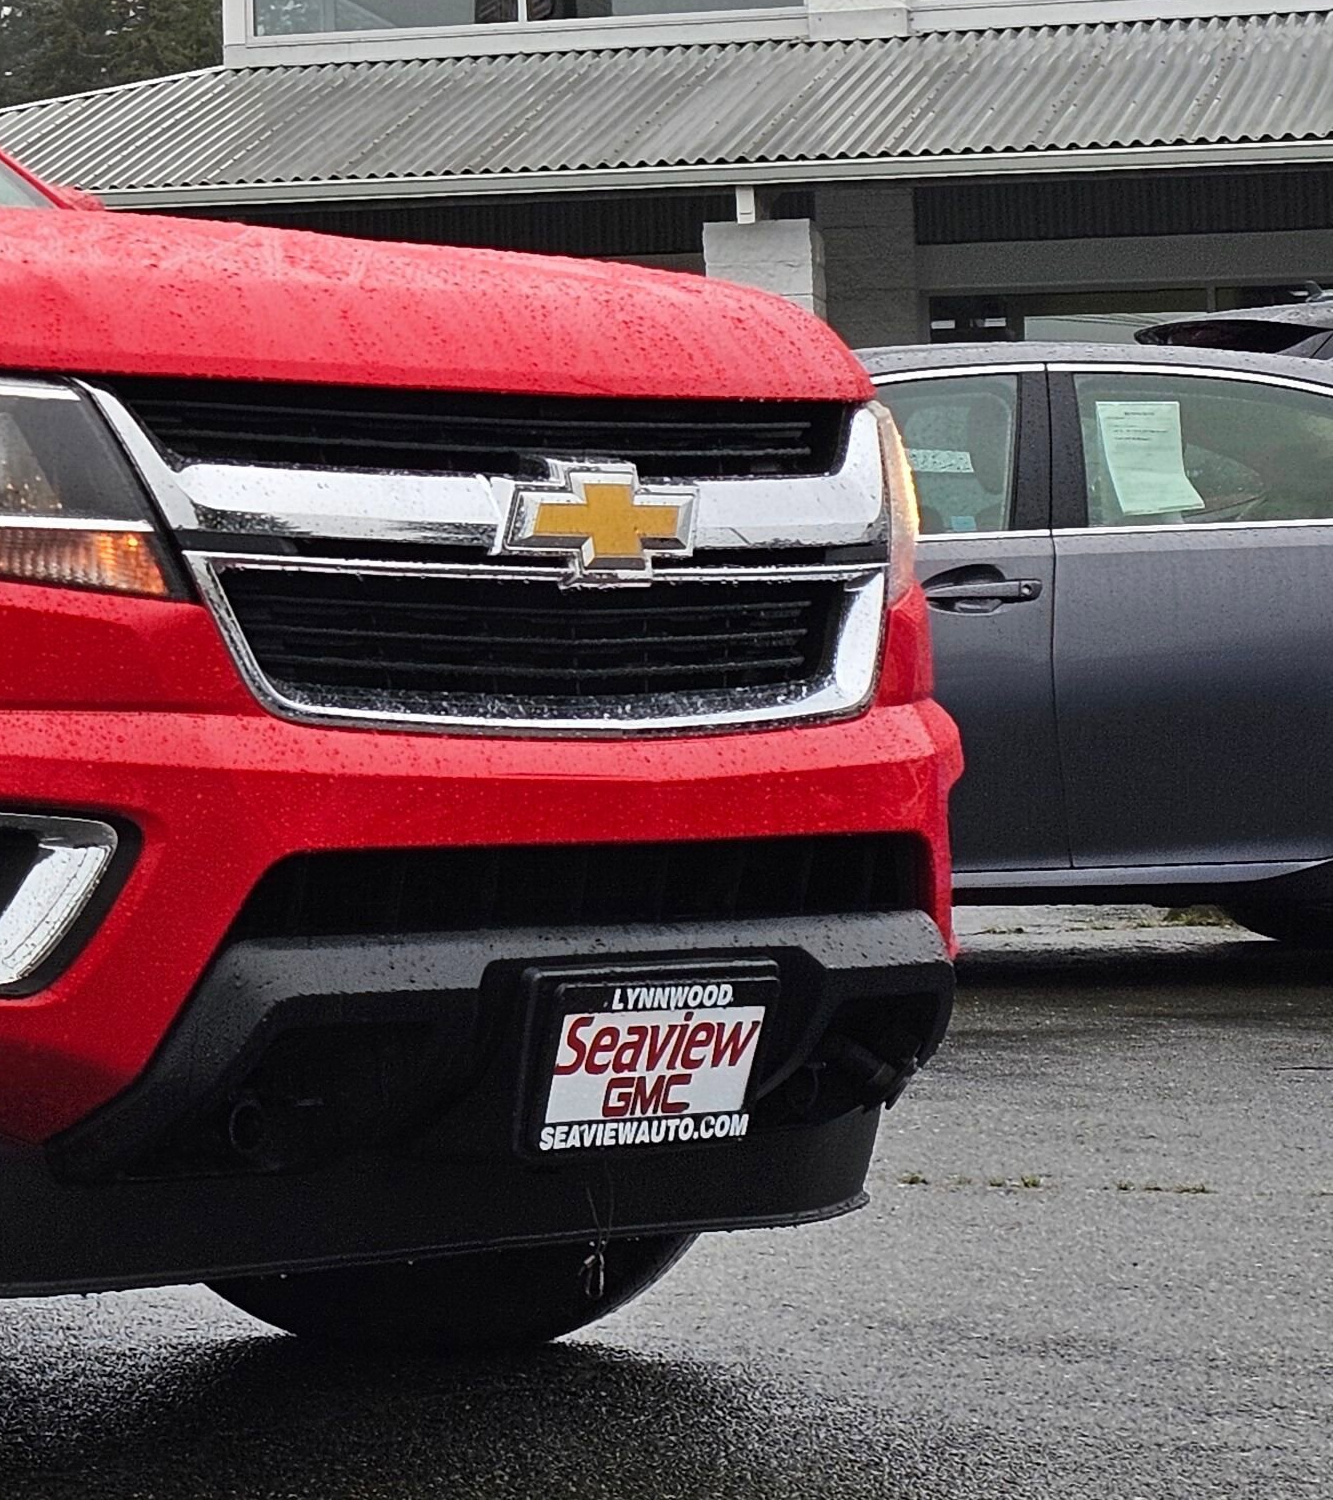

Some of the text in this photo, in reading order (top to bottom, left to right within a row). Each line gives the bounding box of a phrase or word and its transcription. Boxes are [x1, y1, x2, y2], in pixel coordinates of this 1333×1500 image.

[612, 984, 734, 1010] LYNNWOOD
[554, 1012, 761, 1075] Seaview
[602, 1074, 692, 1118] GMC
[539, 1114, 749, 1151] SEAVIEWAUTO.COM
